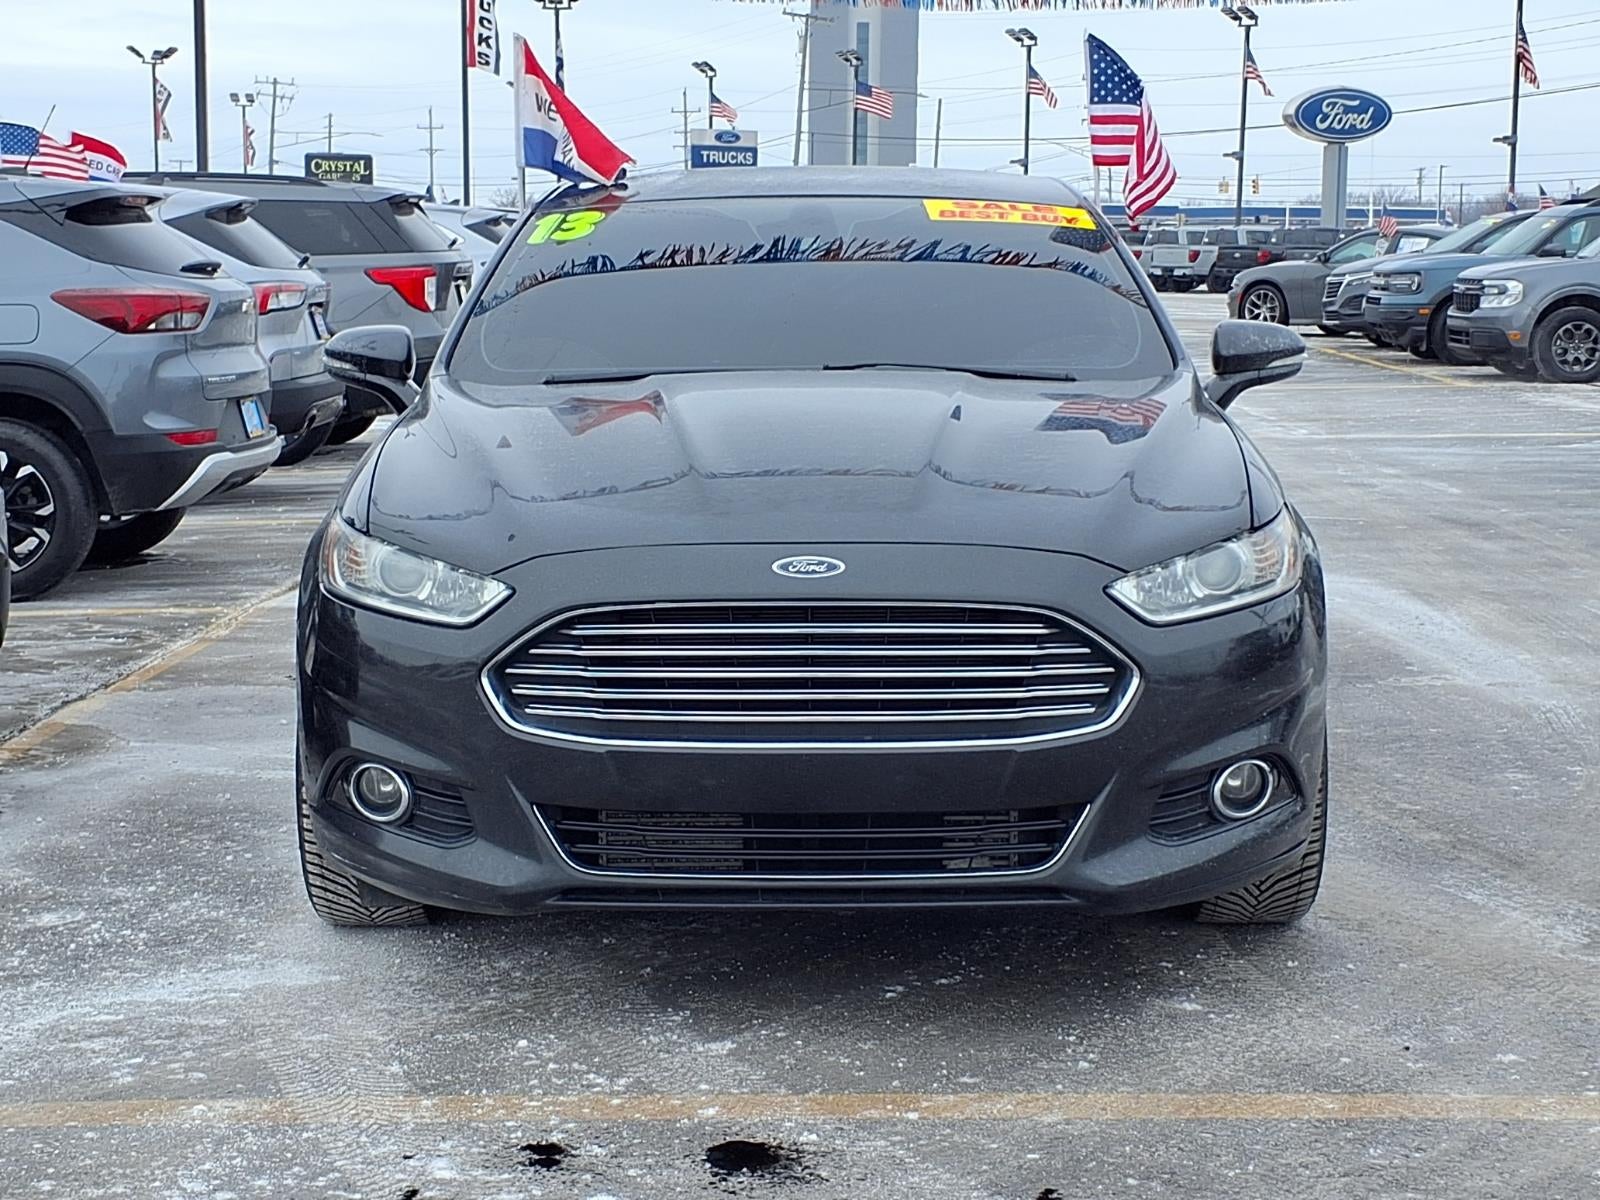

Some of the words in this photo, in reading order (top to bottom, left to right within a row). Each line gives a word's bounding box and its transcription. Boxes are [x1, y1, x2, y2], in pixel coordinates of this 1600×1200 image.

[1315, 98, 1374, 130] Ford
[700, 150, 754, 165] TRUCKS
[310, 158, 370, 175] CRYSTAL
[951, 201, 1058, 216] SALE
[938, 209, 1014, 221] BEST
[1020, 212, 1080, 225] BUY
[788, 559, 828, 573] Ford
